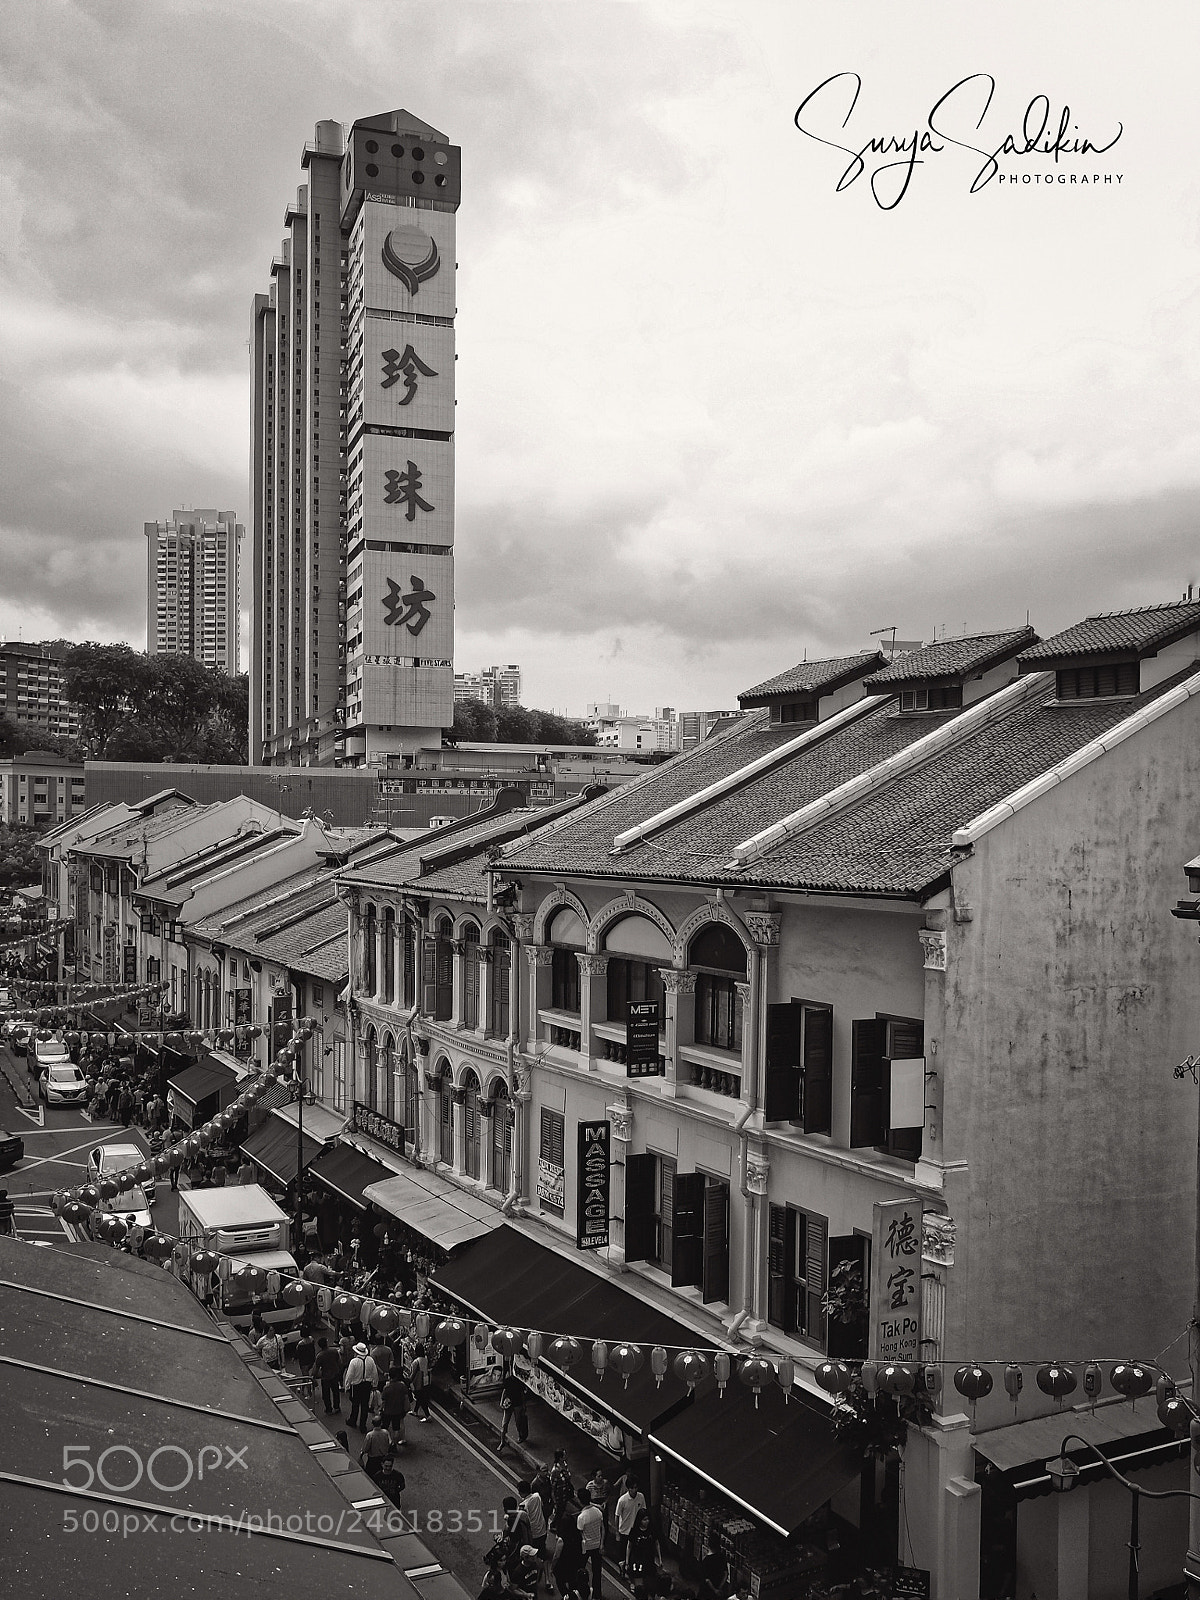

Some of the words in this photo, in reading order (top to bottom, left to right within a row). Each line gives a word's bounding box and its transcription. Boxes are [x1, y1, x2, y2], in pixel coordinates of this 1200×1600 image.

[434, 659, 452, 668] STARS
[630, 1004, 658, 1015] MET
[584, 1126, 606, 1235] MASSAGE
[884, 1211, 918, 1310] 德宝
[880, 1320, 900, 1339] Tak
[902, 1317, 918, 1335] Po
[880, 1340, 898, 1353] Hong
[899, 1338, 917, 1350] Kong
[898, 1352, 913, 1362] Sum
